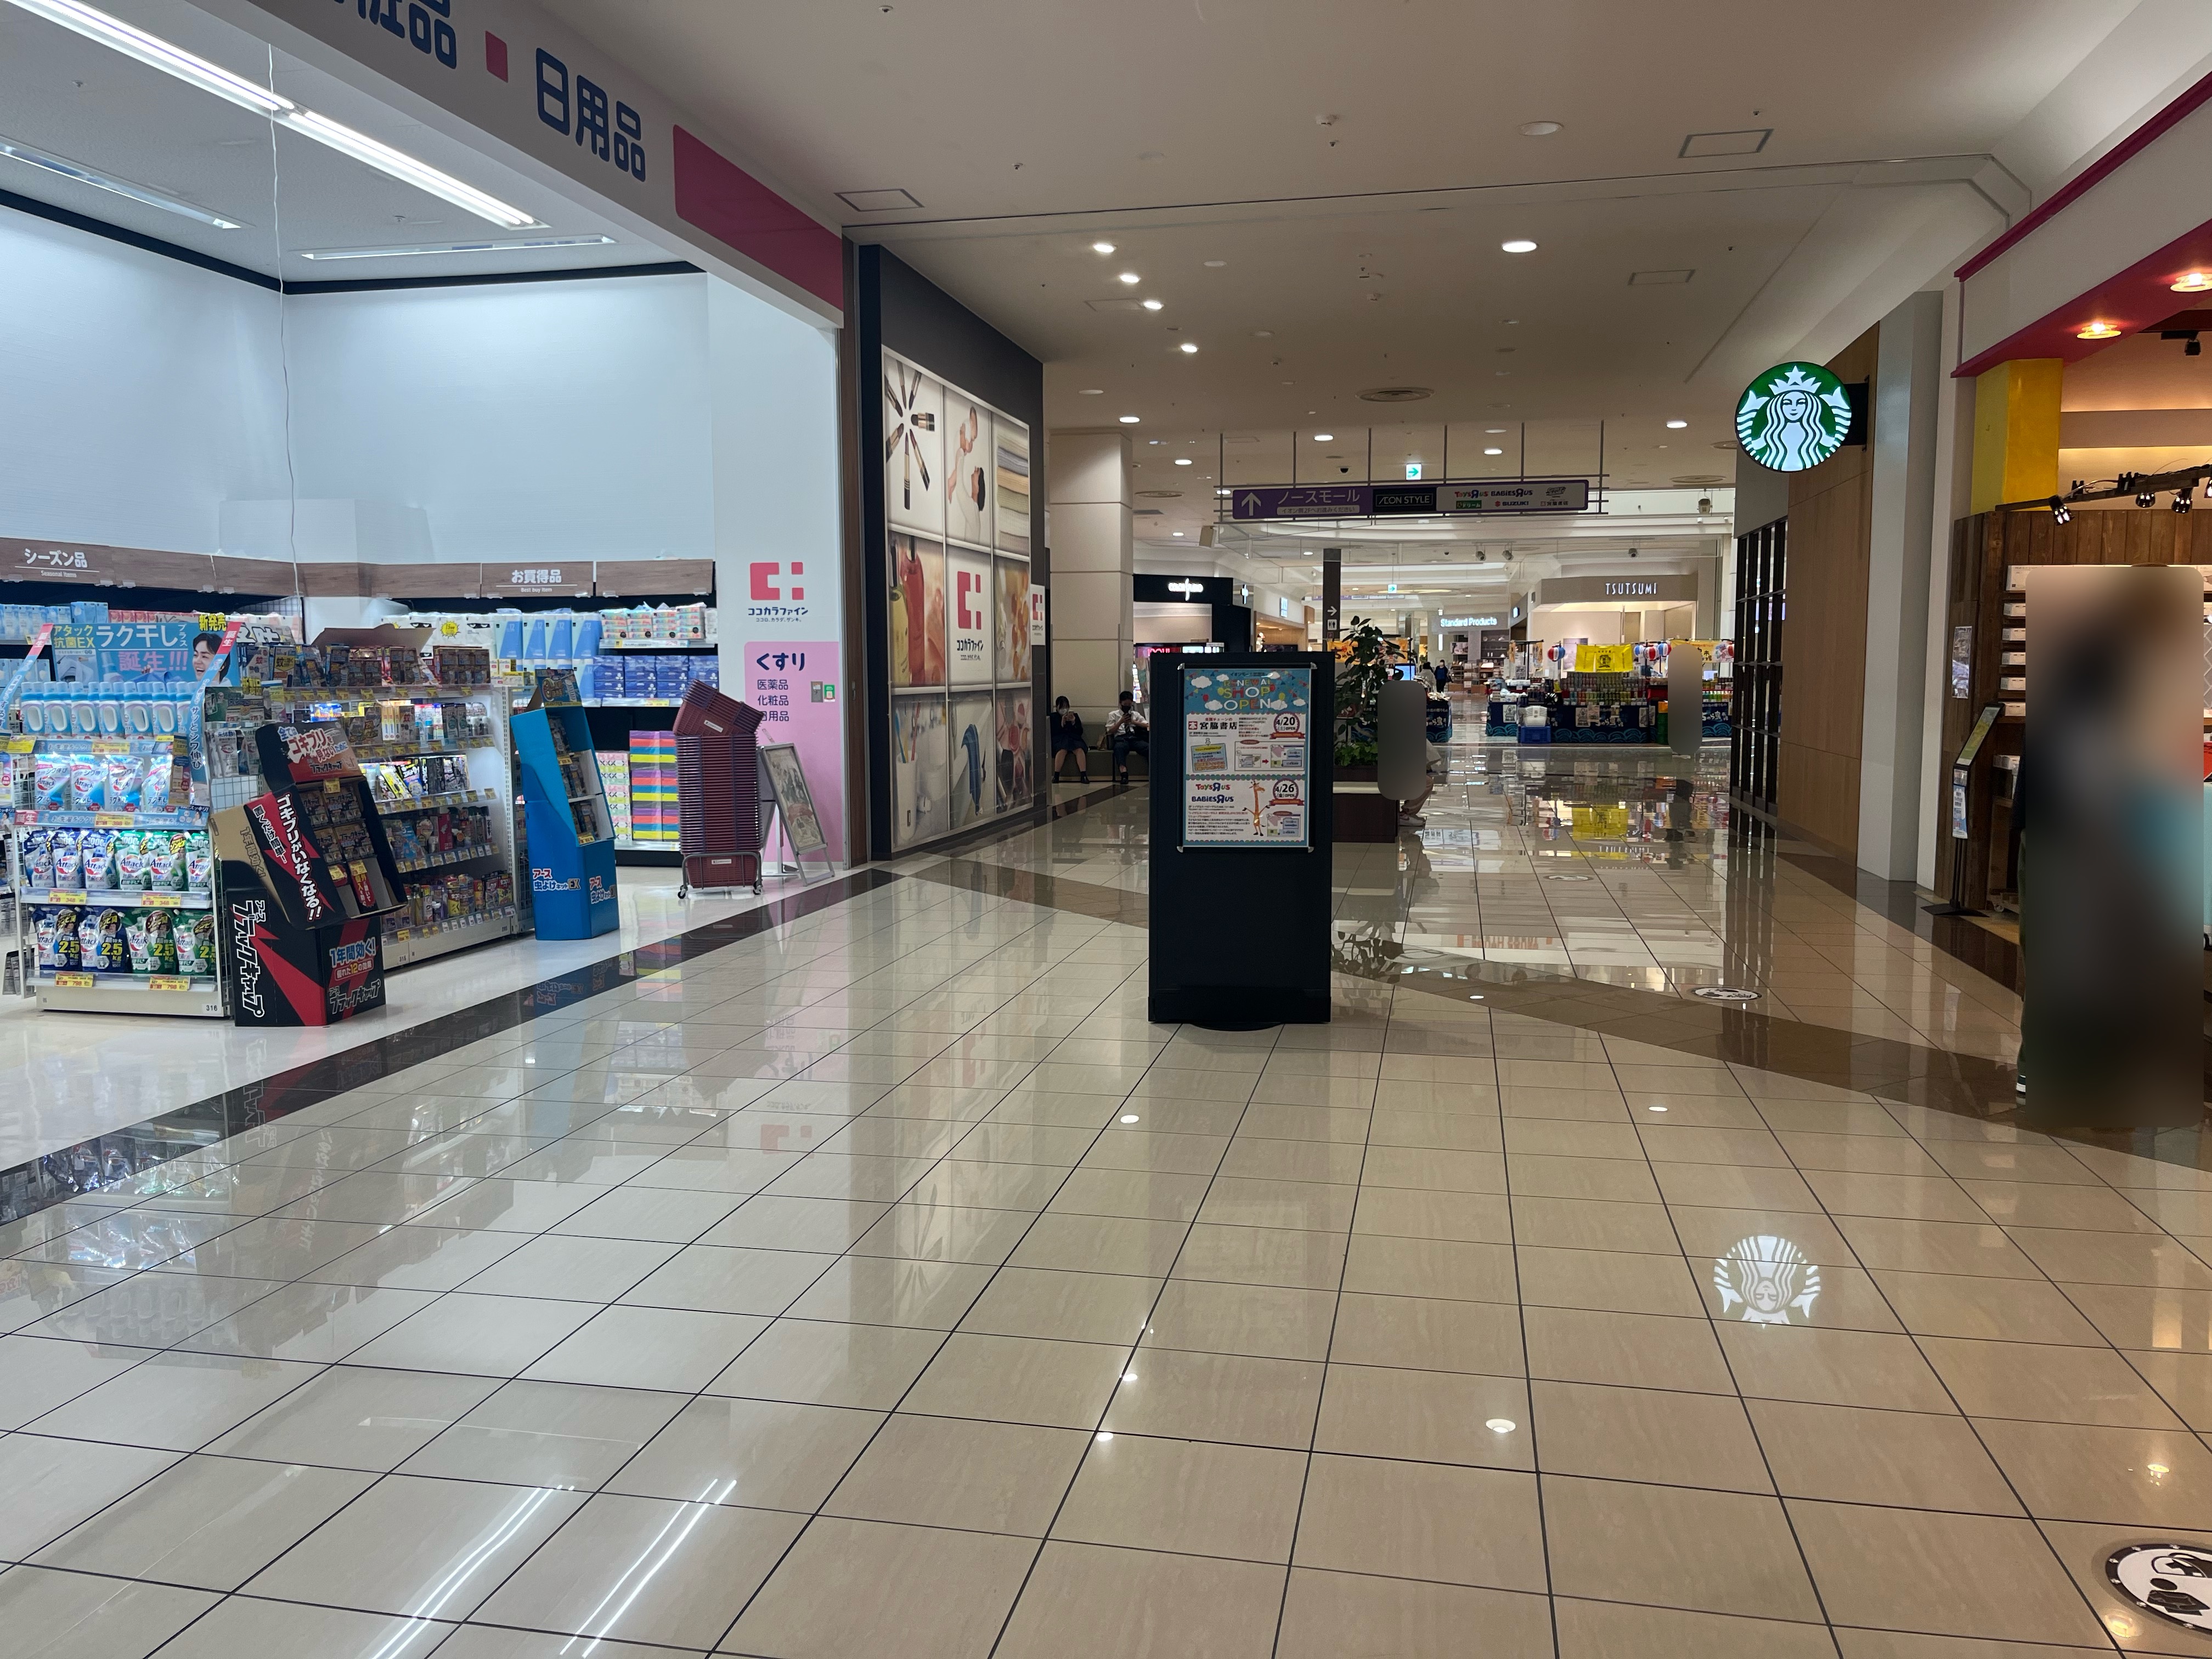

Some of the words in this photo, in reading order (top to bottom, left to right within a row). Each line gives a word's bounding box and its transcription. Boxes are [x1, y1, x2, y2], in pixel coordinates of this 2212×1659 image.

[536, 48, 646, 182] 日用品
[1278, 489, 1359, 504] ノースモール
[1404, 495, 1429, 504] STYLE
[24, 548, 88, 568] シーズン品
[512, 569, 562, 583] お買得品
[1606, 583, 1657, 595] TSUTSUMI
[748, 607, 808, 615] ココカラファイン
[199, 613, 228, 631] 新発売
[1440, 618, 1468, 627] Standard
[1469, 617, 1497, 625] Products
[53, 625, 93, 637] アタック
[96, 625, 178, 648] ラク干し
[177, 624, 188, 647] プラス
[54, 636, 95, 648] 抗菌EX
[222, 631, 236, 647] 誕生
[957, 639, 983, 651] ココカラファイン
[757, 652, 804, 671] くすり
[757, 679, 788, 690] 医薬品
[1223, 686, 1271, 699] SHOP
[758, 695, 789, 706] 化粧品
[1223, 698, 1271, 710] OPEN
[1200, 721, 1238, 730] 宮脇書店
[1276, 717, 1295, 726] 4/20
[1275, 783, 1295, 792] 4/26
[121, 858, 144, 868] Attack
[150, 859, 172, 868] Attack
[278, 794, 321, 921] ゴキブリがいなくなる!!
[532, 868, 552, 879] アース
[533, 878, 581, 891] 虫よけネットEX
[589, 876, 602, 890] アース
[255, 900, 266, 923] アース
[59, 940, 80, 953] 2.5
[101, 943, 122, 955] 2.5
[154, 944, 174, 956] 2.5
[329, 937, 376, 968] 1年間効く!
[233, 900, 265, 1018] ブラックキャップ
[330, 979, 381, 1014] ブラックキャップ
